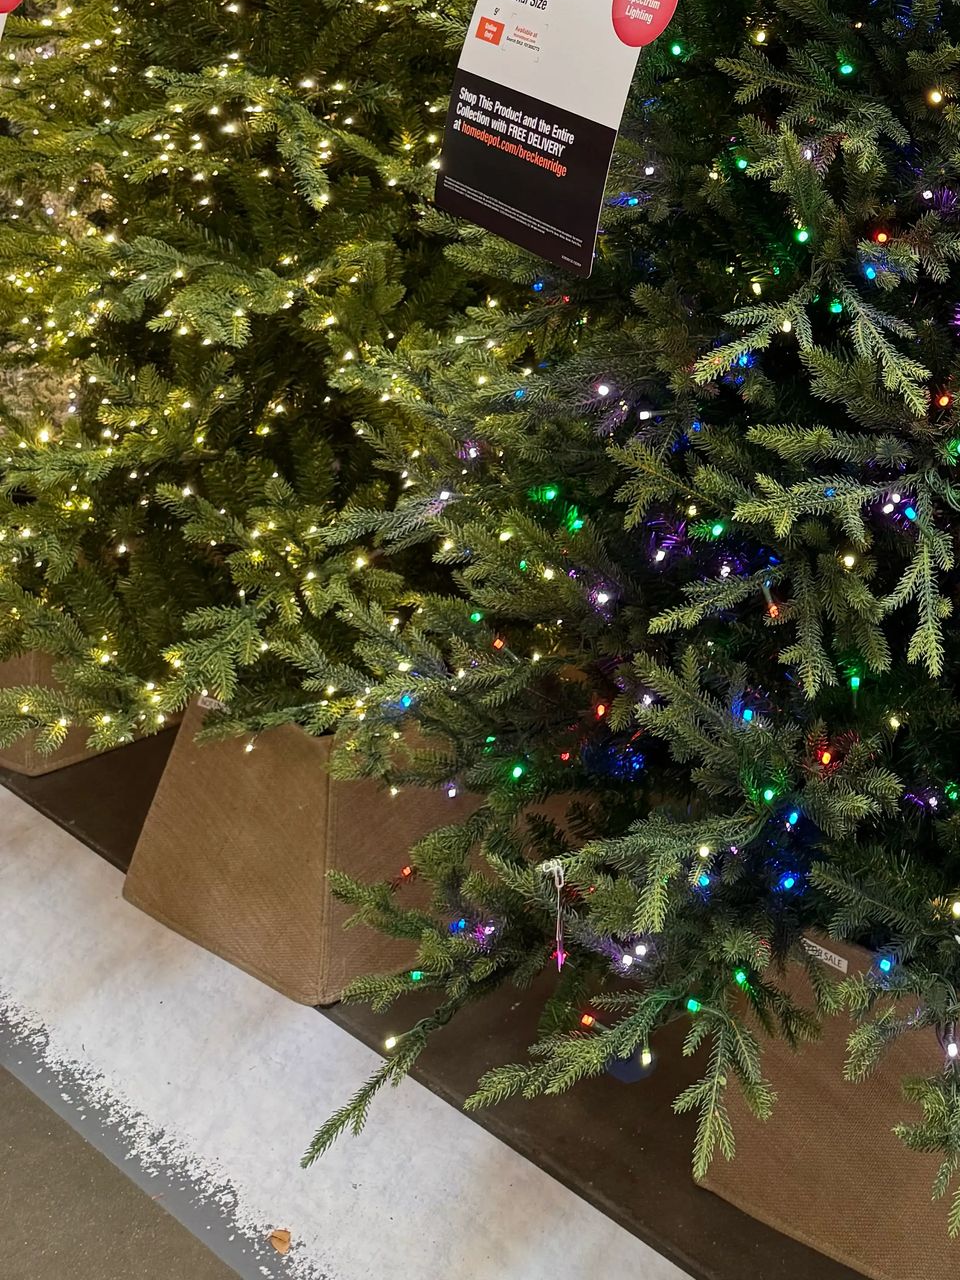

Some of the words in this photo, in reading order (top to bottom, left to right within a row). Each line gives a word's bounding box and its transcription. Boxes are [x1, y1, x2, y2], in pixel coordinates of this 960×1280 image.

[625, 5, 653, 24] Lighting
[456, 102, 491, 127] Collection
[491, 117, 507, 134] with
[507, 125, 527, 142] FREE
[527, 132, 564, 158] DELIVERY
[459, 86, 477, 107] Shop
[478, 94, 493, 112] This
[493, 101, 523, 124] Product
[522, 114, 538, 129] and
[538, 118, 551, 135] the
[551, 125, 575, 145] Entire
[452, 118, 462, 132] at
[461, 121, 568, 178] homedepot.com/breckenridge
[824, 952, 842, 968] SALE
